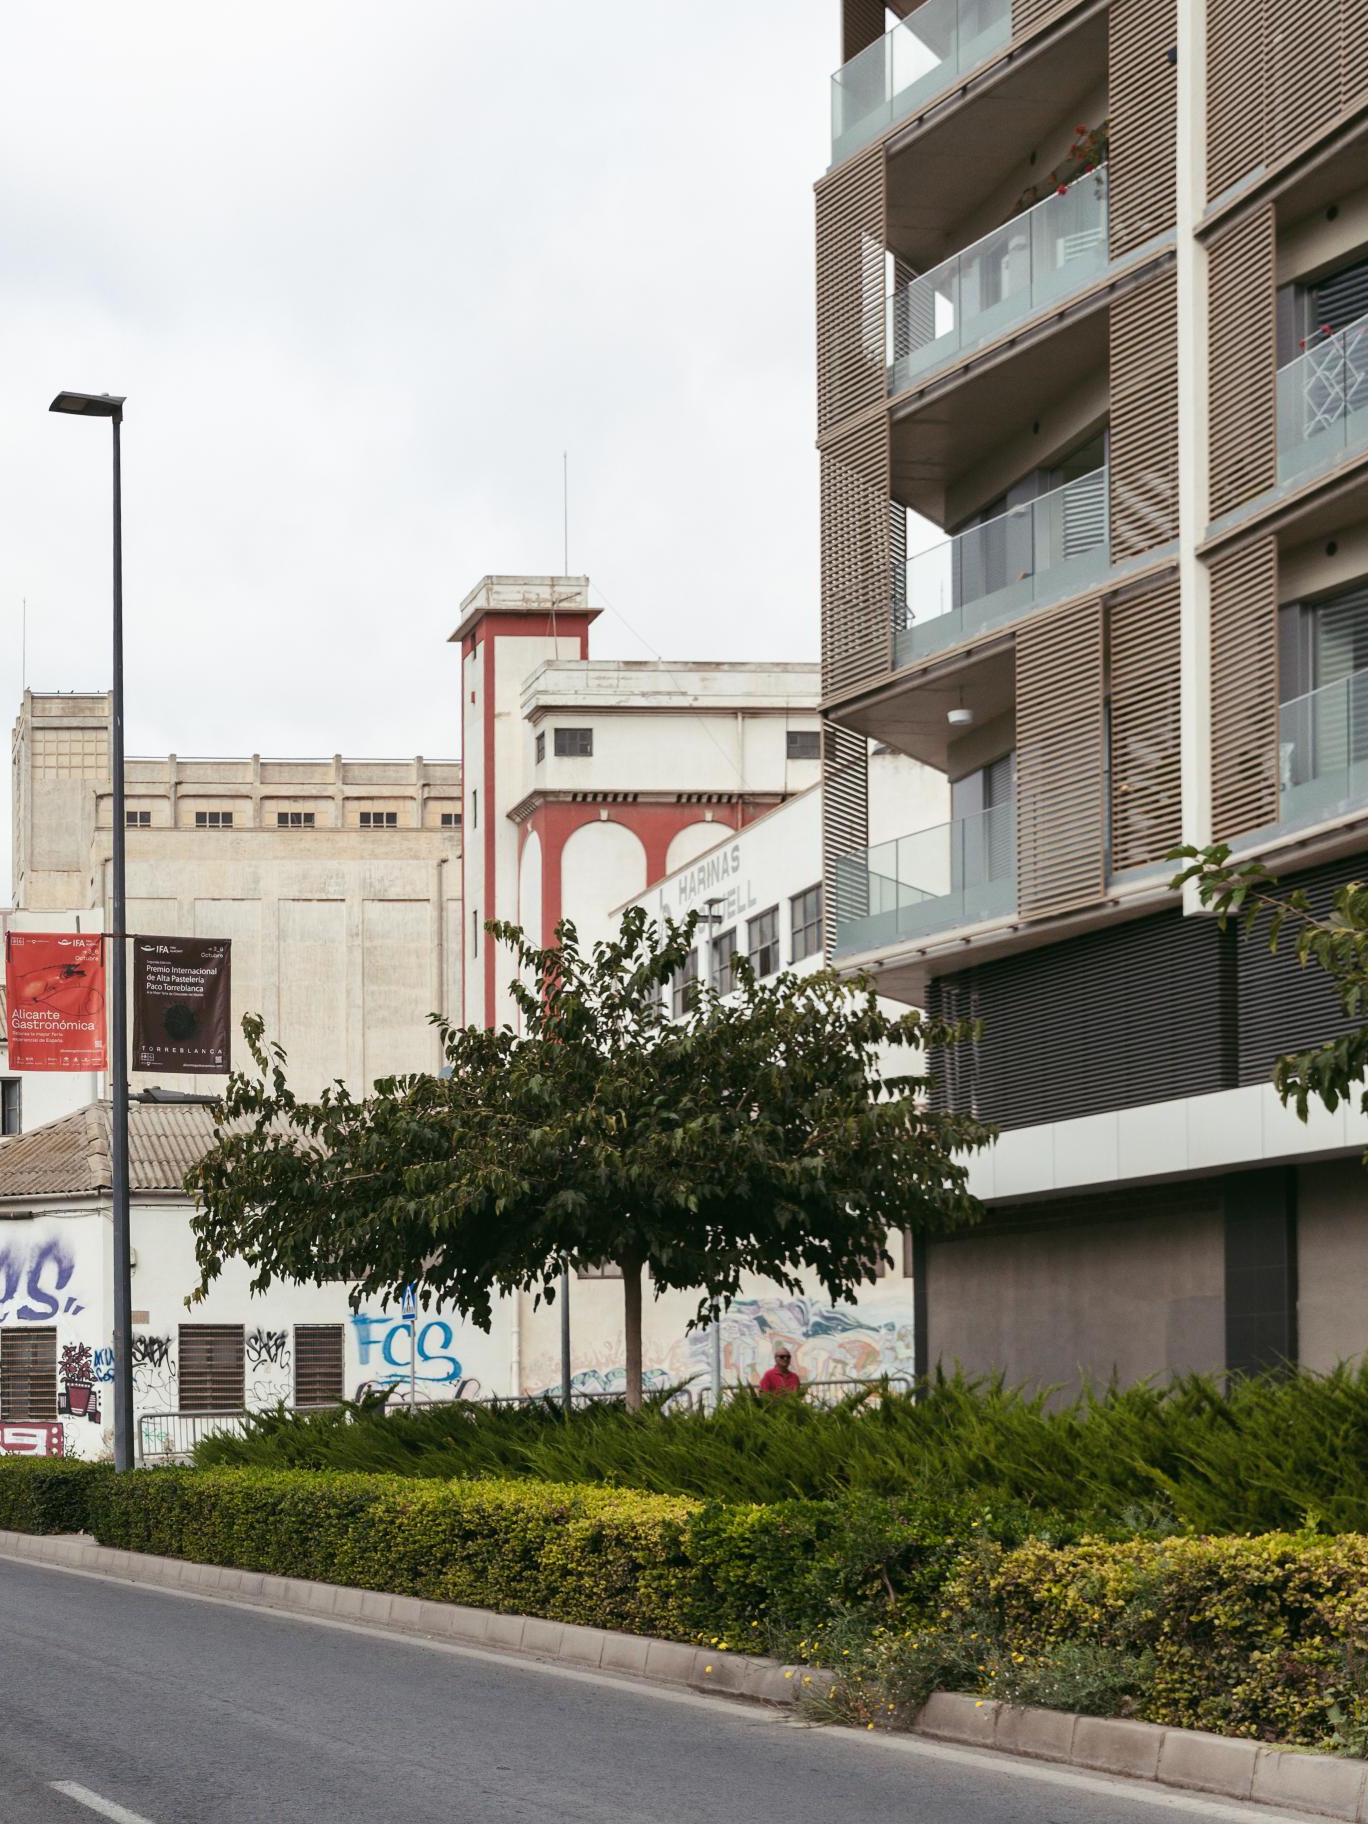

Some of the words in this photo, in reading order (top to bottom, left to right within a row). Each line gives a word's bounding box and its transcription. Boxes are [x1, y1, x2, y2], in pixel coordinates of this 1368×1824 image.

[678, 844, 741, 905] HARINAS
[73, 939, 85, 947] IFA
[156, 945, 169, 953] IFA
[146, 964, 170, 973] Premio
[171, 966, 217, 975] Internacional
[146, 982, 162, 991] Paco
[163, 983, 204, 992] Torreblanca
[11, 1009, 60, 1020] Alicante
[11, 1018, 95, 1030] Gastronómica
[141, 1045, 223, 1054] TORREBLANCA
